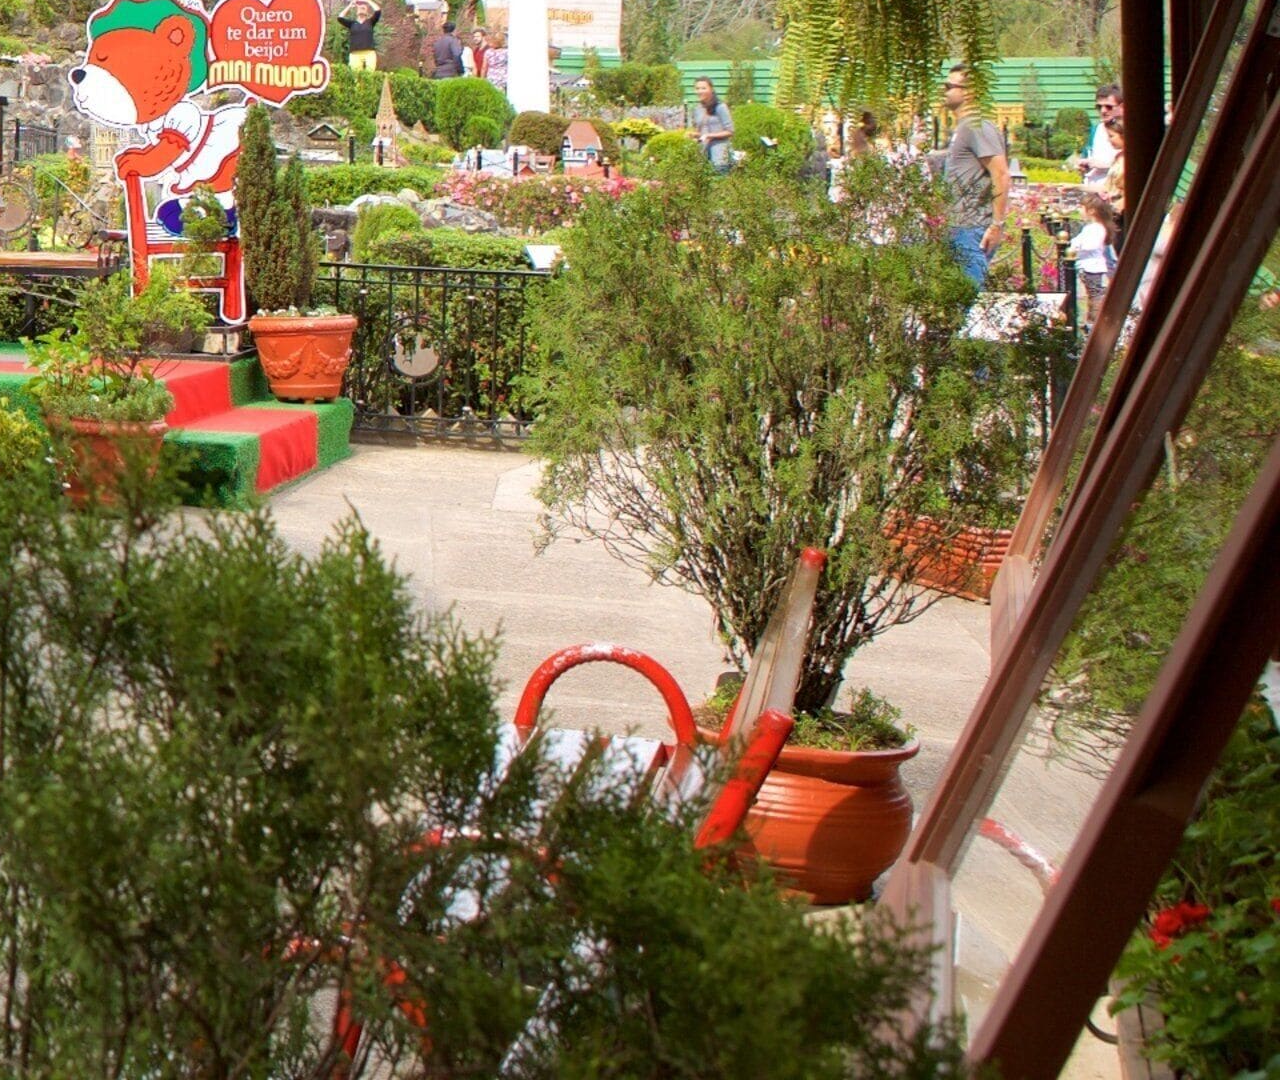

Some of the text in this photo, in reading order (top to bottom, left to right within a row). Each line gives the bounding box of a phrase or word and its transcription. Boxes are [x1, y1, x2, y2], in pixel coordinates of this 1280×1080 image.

[240, 6, 293, 24] Quero
[227, 23, 307, 40] te dar um
[244, 41, 288, 62] beijo!
